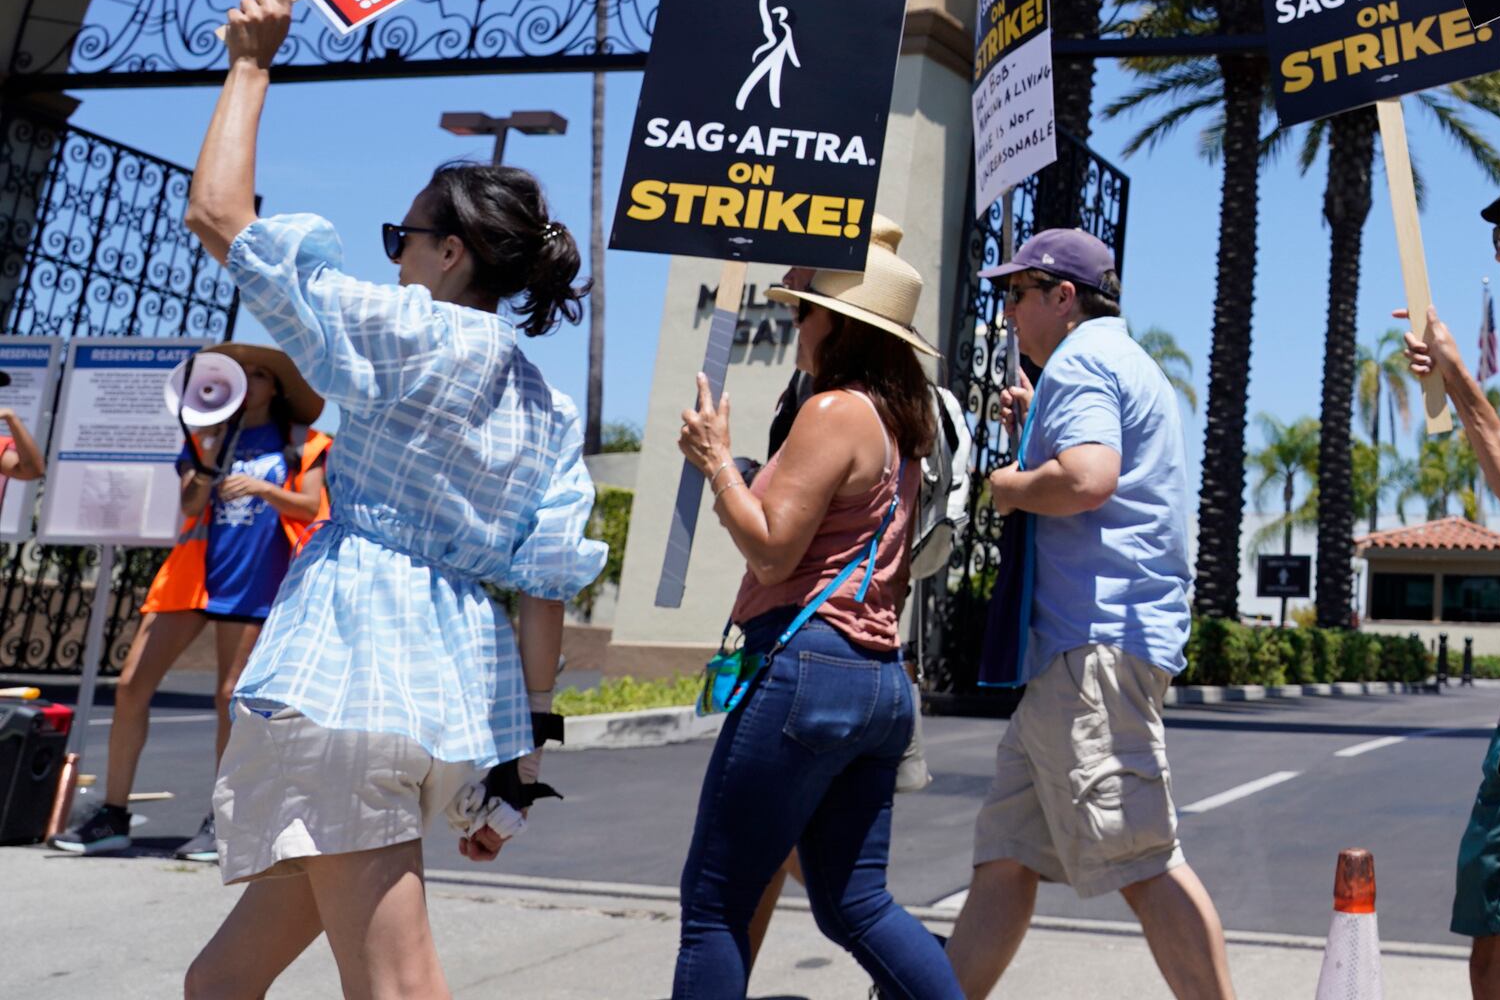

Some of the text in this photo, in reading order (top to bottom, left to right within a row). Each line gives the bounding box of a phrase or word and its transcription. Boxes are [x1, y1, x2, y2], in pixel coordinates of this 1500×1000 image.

[1356, 1, 1399, 28] ON
[1004, 87, 1011, 105] A
[1014, 64, 1051, 96] LIVING
[996, 125, 1005, 139] IS
[1009, 108, 1034, 130] NOT
[980, 120, 1053, 192] UNREASONABLE
[728, 162, 775, 186] ON
[626, 179, 865, 239] STRIKE!
[733, 320, 794, 345] GAT
[91, 349, 154, 361] RESERVED
